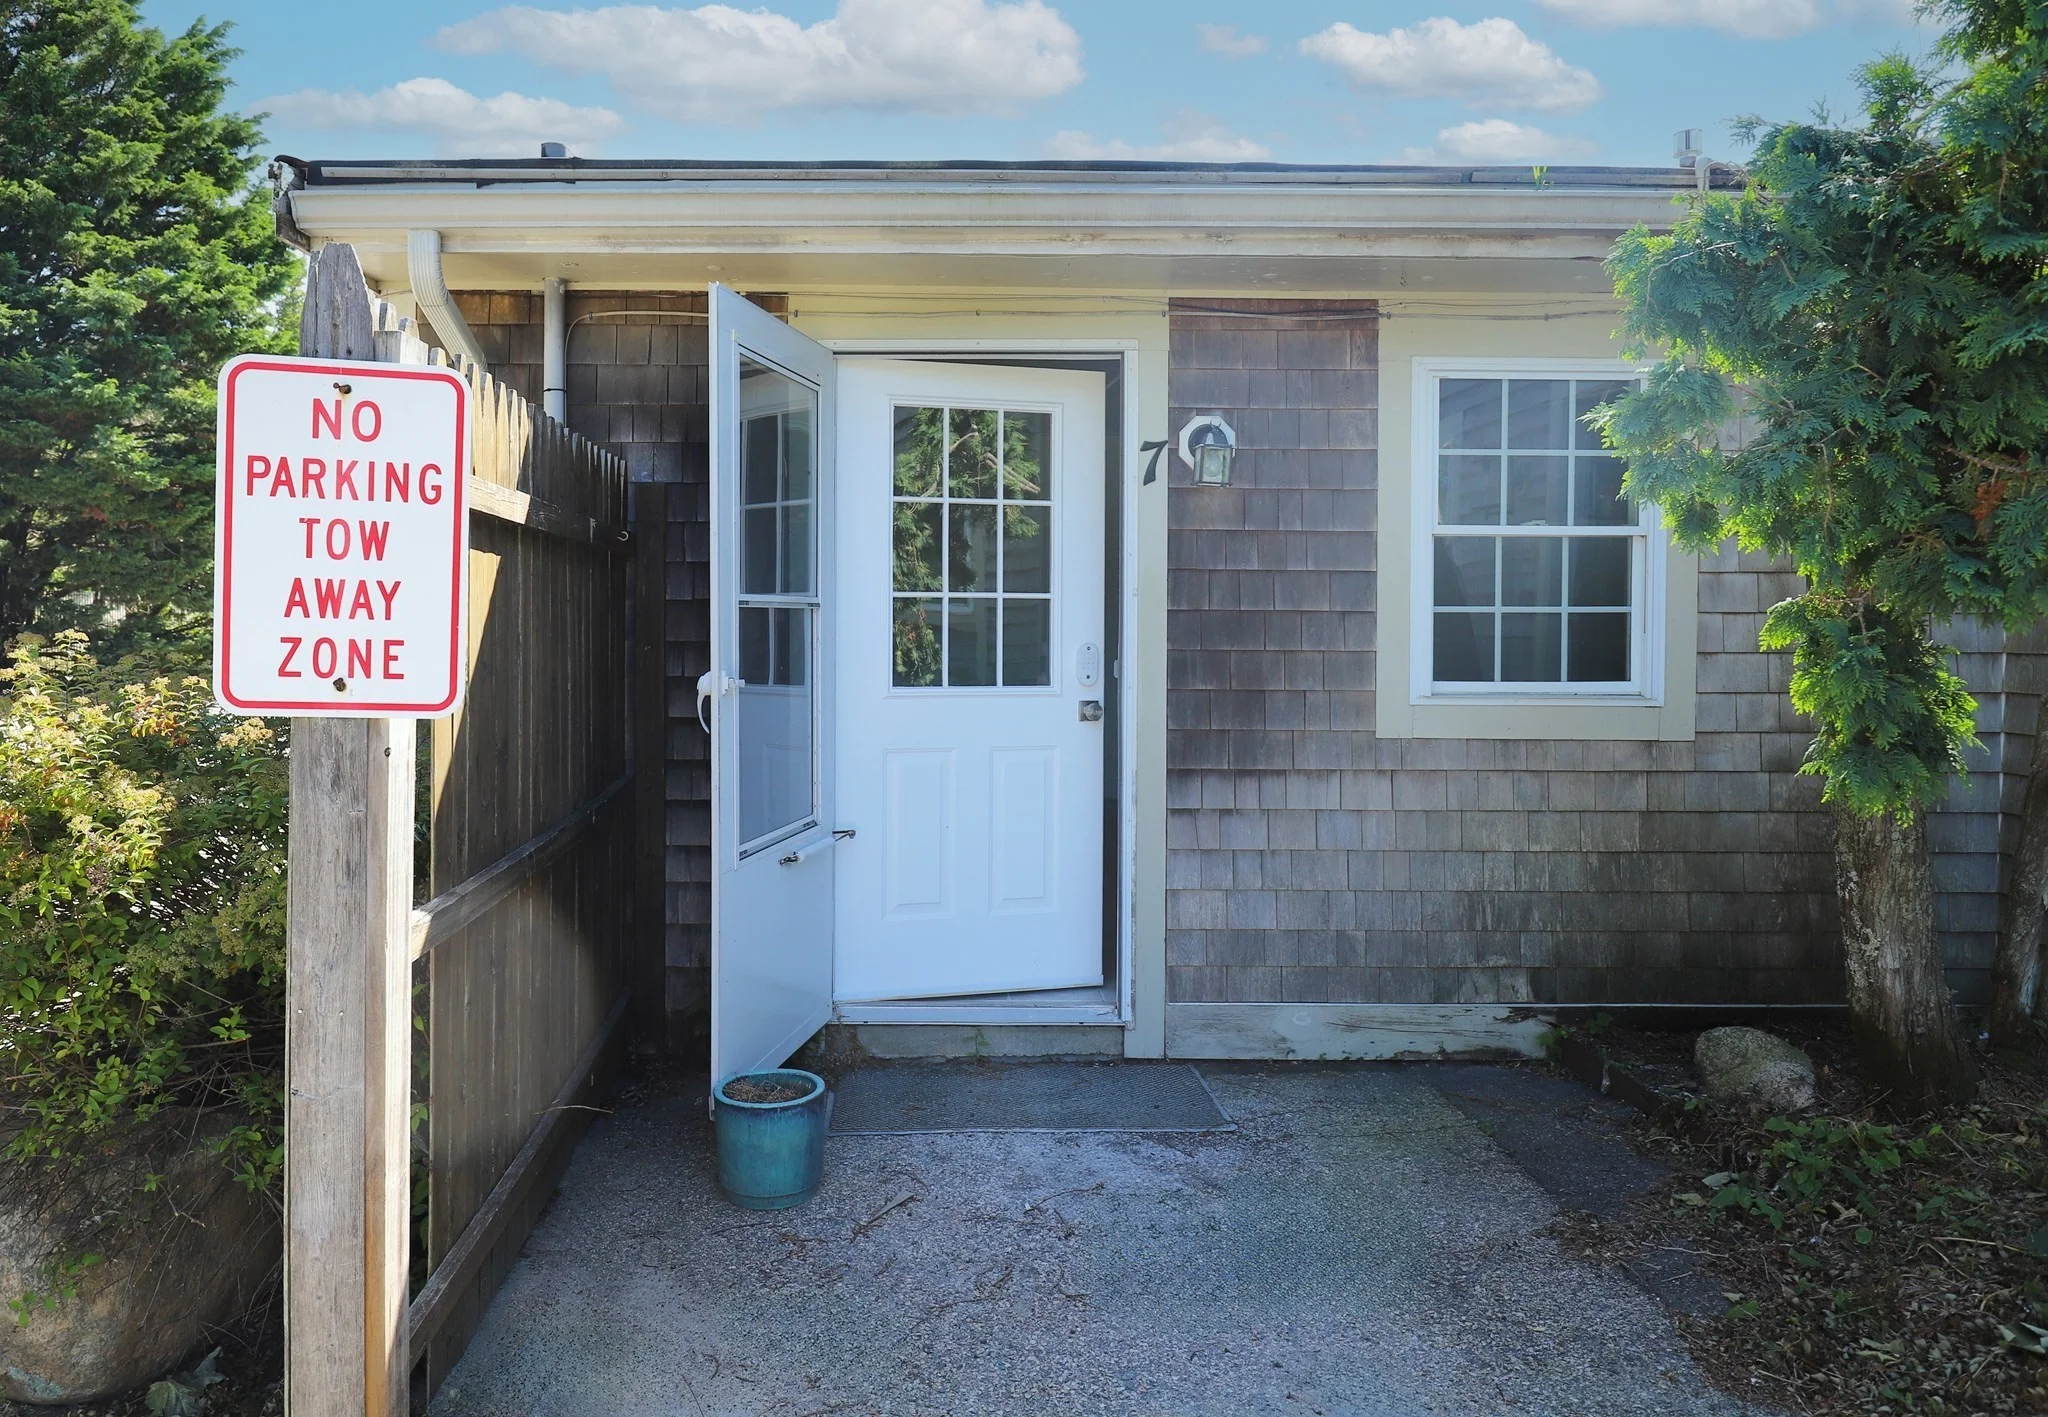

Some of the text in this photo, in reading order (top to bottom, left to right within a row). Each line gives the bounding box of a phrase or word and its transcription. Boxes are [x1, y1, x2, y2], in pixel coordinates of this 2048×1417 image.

[311, 397, 382, 442] NO
[246, 455, 442, 505] PARKING
[1139, 440, 1169, 486] 7
[299, 517, 390, 561] TOW
[284, 577, 401, 621] AWAY
[278, 637, 405, 680] ZONE
